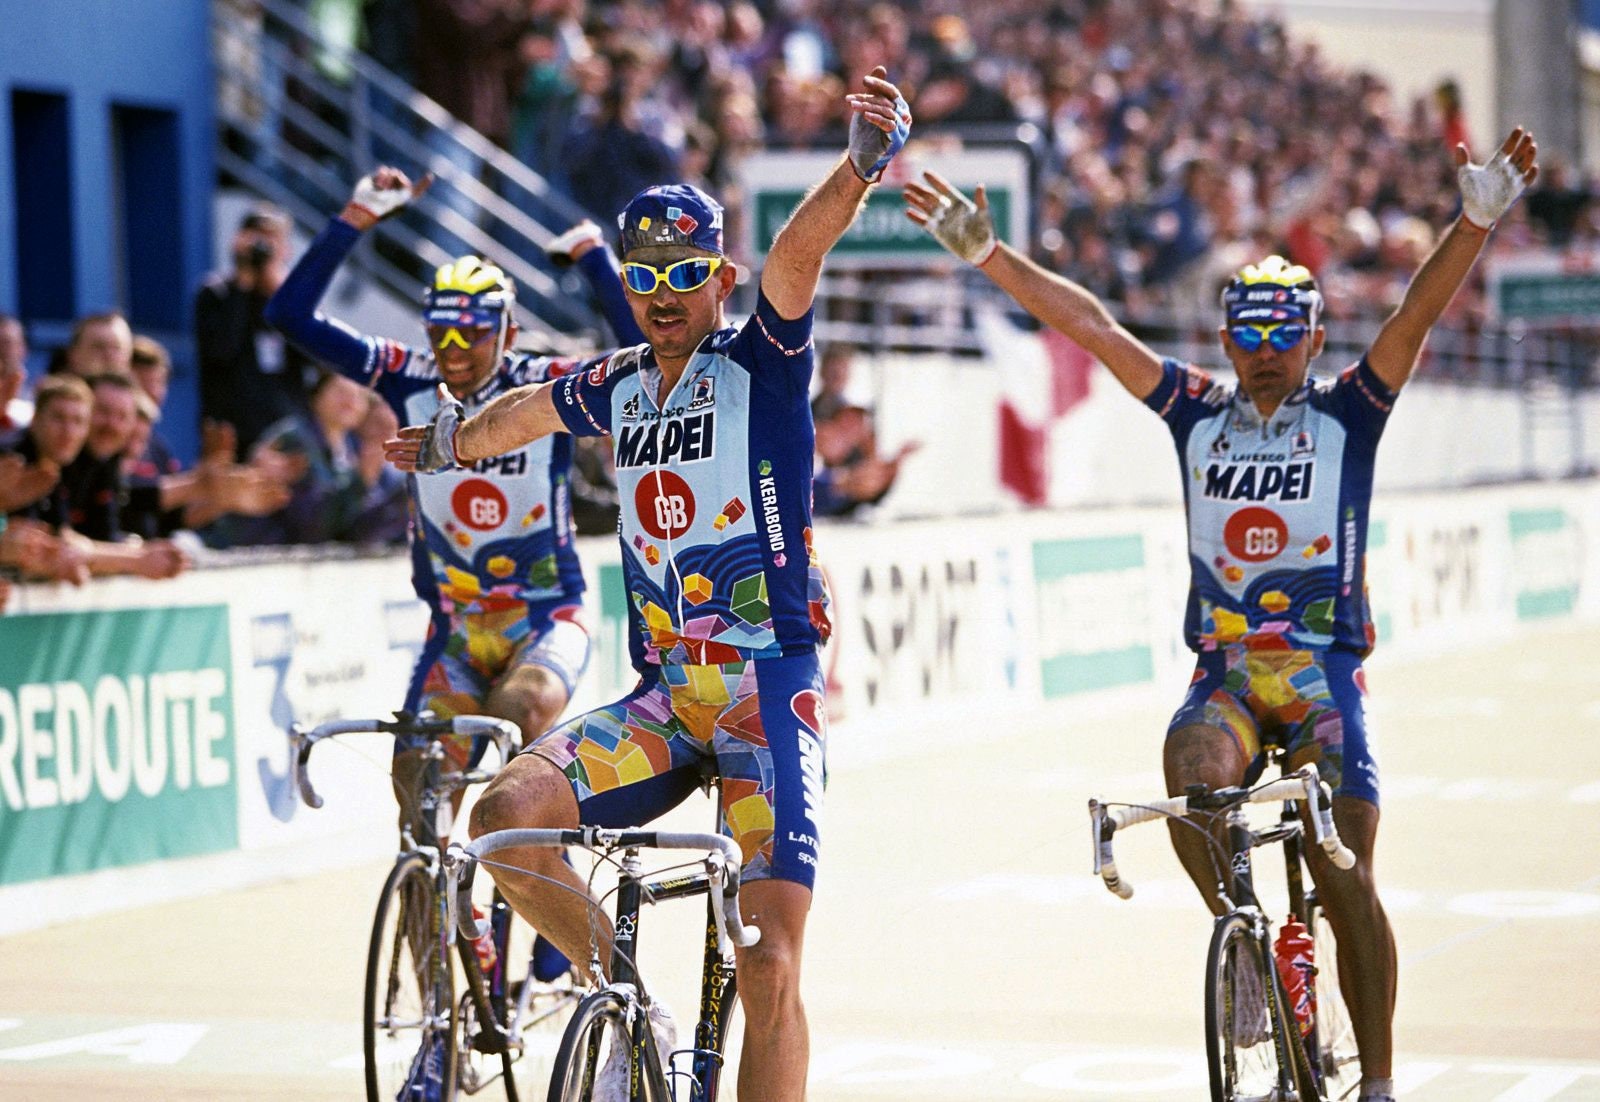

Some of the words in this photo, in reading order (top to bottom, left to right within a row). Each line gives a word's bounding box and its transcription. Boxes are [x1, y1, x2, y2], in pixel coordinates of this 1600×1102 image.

[615, 412, 715, 468] MAPEI
[1204, 462, 1313, 501] MAPEI
[470, 496, 501, 526] GB
[654, 495, 688, 530] GB
[759, 476, 785, 552] KERABOND
[1244, 526, 1280, 556] GB
[0, 667, 232, 813] REDOUTE
